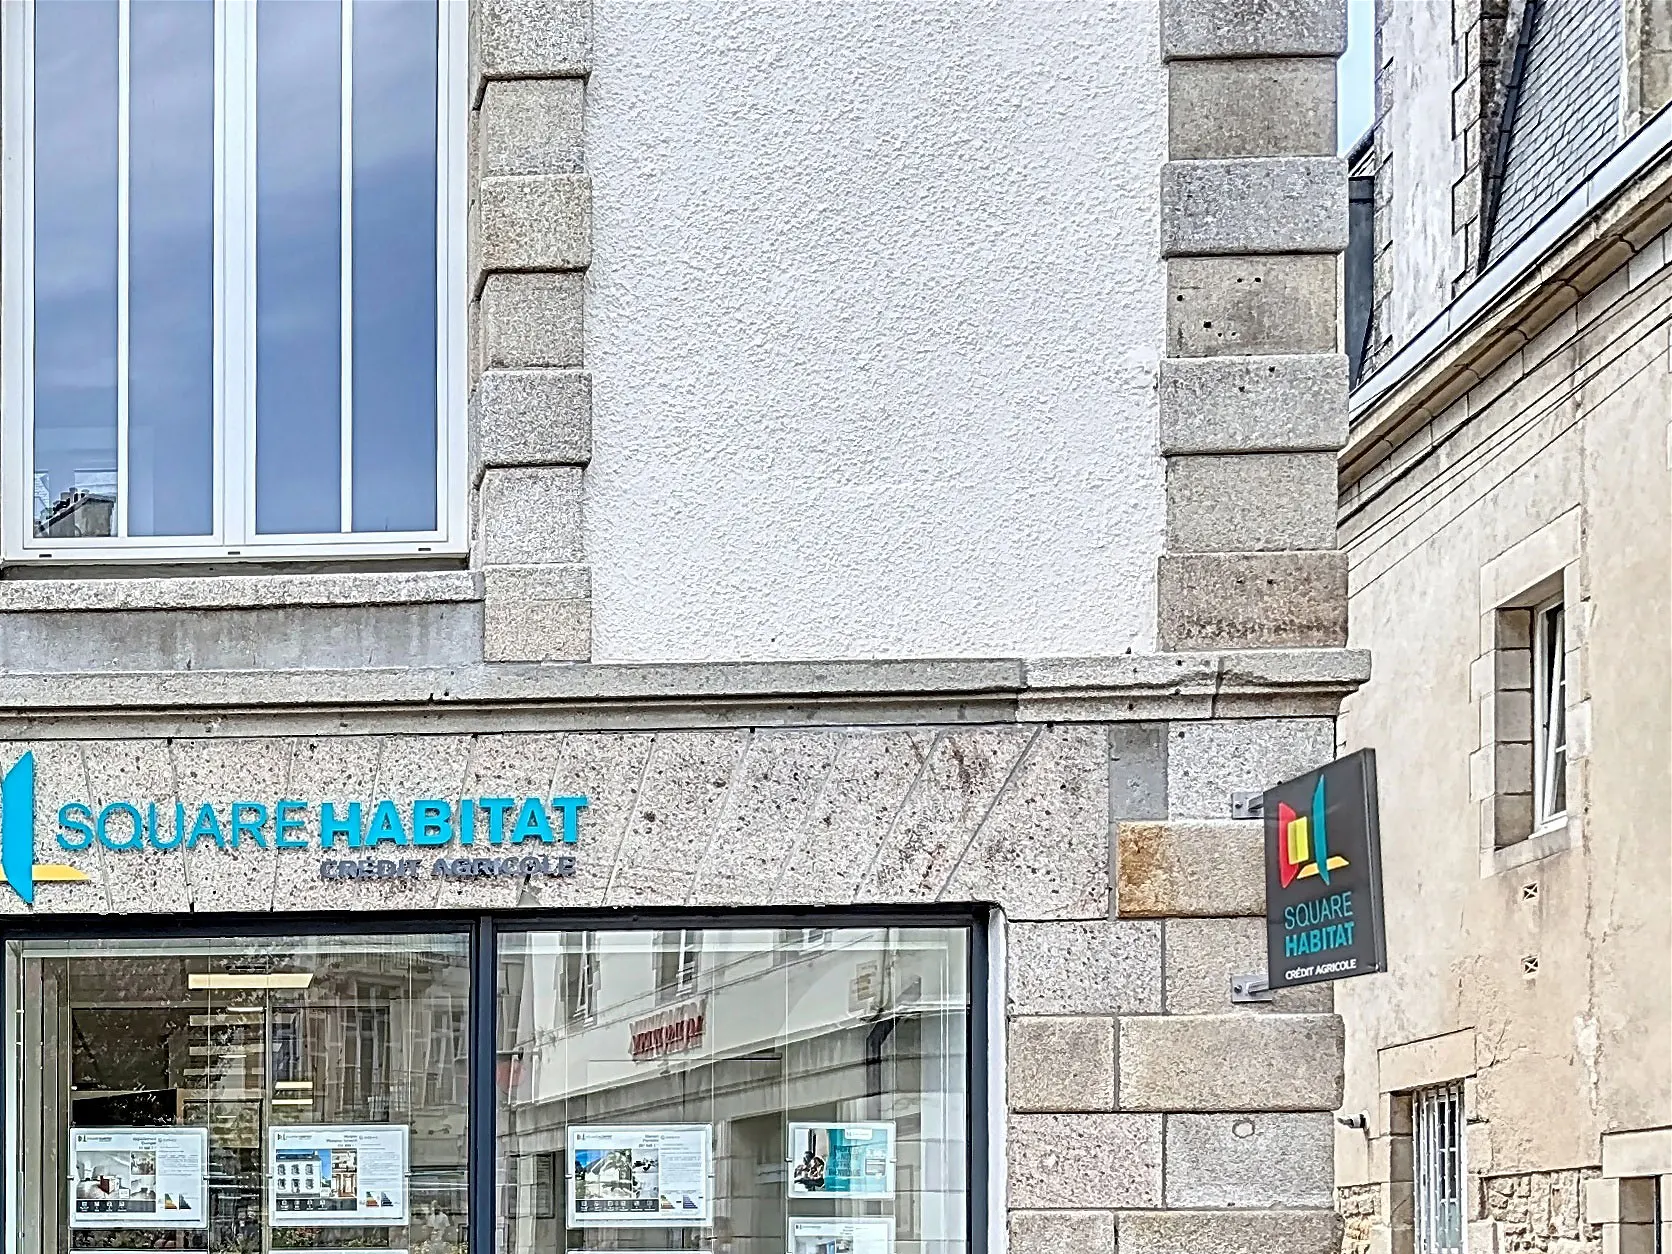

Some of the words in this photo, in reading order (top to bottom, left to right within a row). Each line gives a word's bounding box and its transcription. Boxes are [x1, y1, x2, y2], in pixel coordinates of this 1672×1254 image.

[57, 800, 310, 851] SQUARE
[320, 796, 589, 848] HABITAT
[319, 855, 424, 880] CRÉDIT
[430, 855, 578, 878] AGRICOLE
[1285, 891, 1353, 929] SQUARE
[1285, 921, 1355, 957] HABITAT
[1285, 967, 1315, 980] CRÉDIT
[1315, 958, 1357, 975] AGRICOLE
